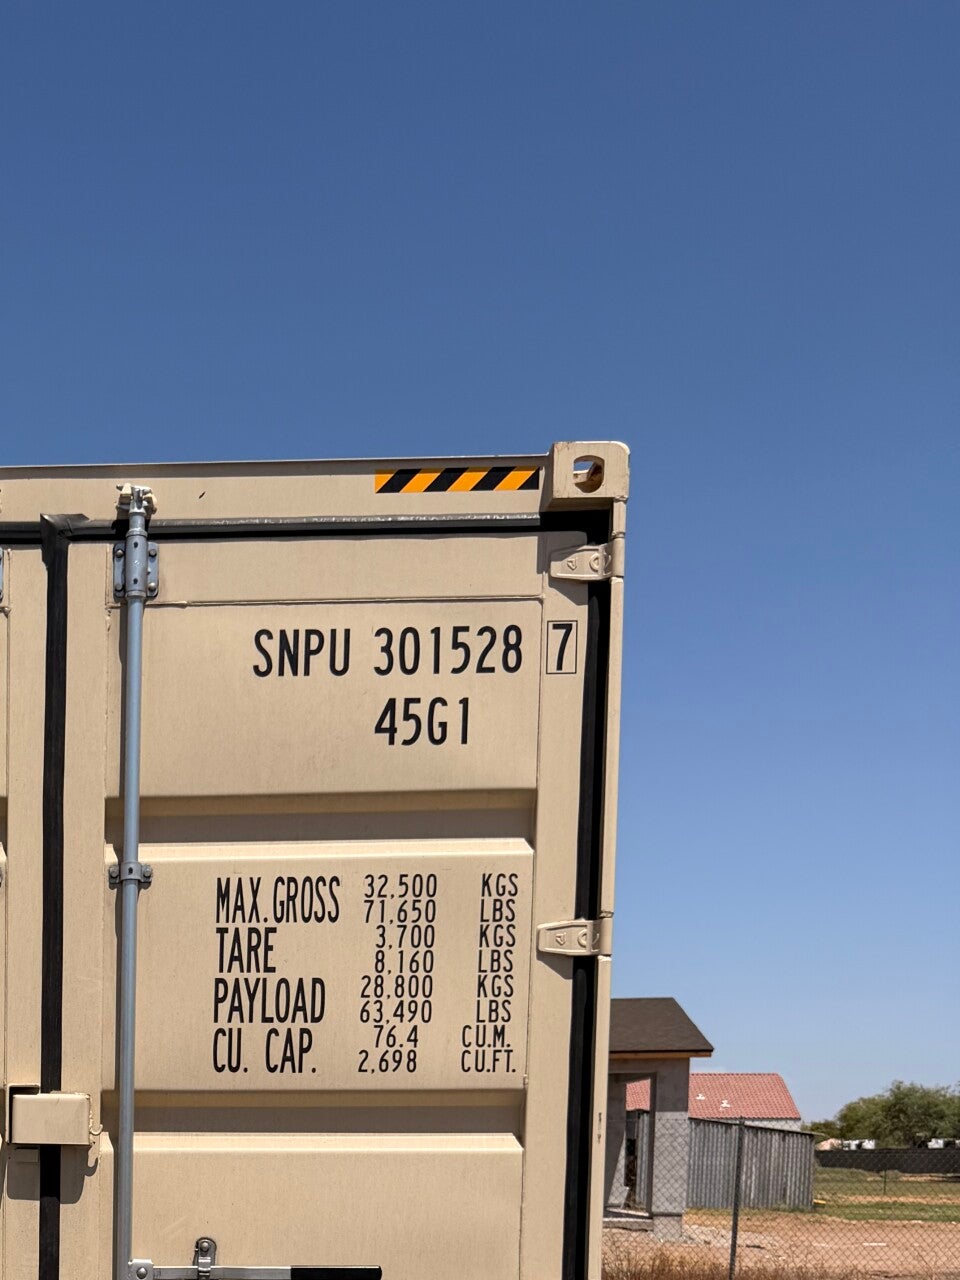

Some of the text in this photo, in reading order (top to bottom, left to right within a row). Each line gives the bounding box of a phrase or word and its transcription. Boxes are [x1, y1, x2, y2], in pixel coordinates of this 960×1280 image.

[252, 622, 573, 678] SNPU 301528 7
[374, 696, 469, 746] 45G1
[364, 873, 437, 899] 32,500
[481, 873, 519, 898] KGS
[363, 898, 516, 924] 71,650 LBS
[215, 923, 516, 974] TARE 3,700 KGS
[374, 949, 514, 975] 8,160 LBS
[213, 974, 514, 1024] PAYLOAD 28,800 KGS
[359, 999, 512, 1024] 63,490 LBS
[212, 1027, 249, 1074] CU.
[265, 1027, 317, 1074] CAP.
[373, 1024, 419, 1049] 76.4
[357, 1049, 417, 1075] 2,698
